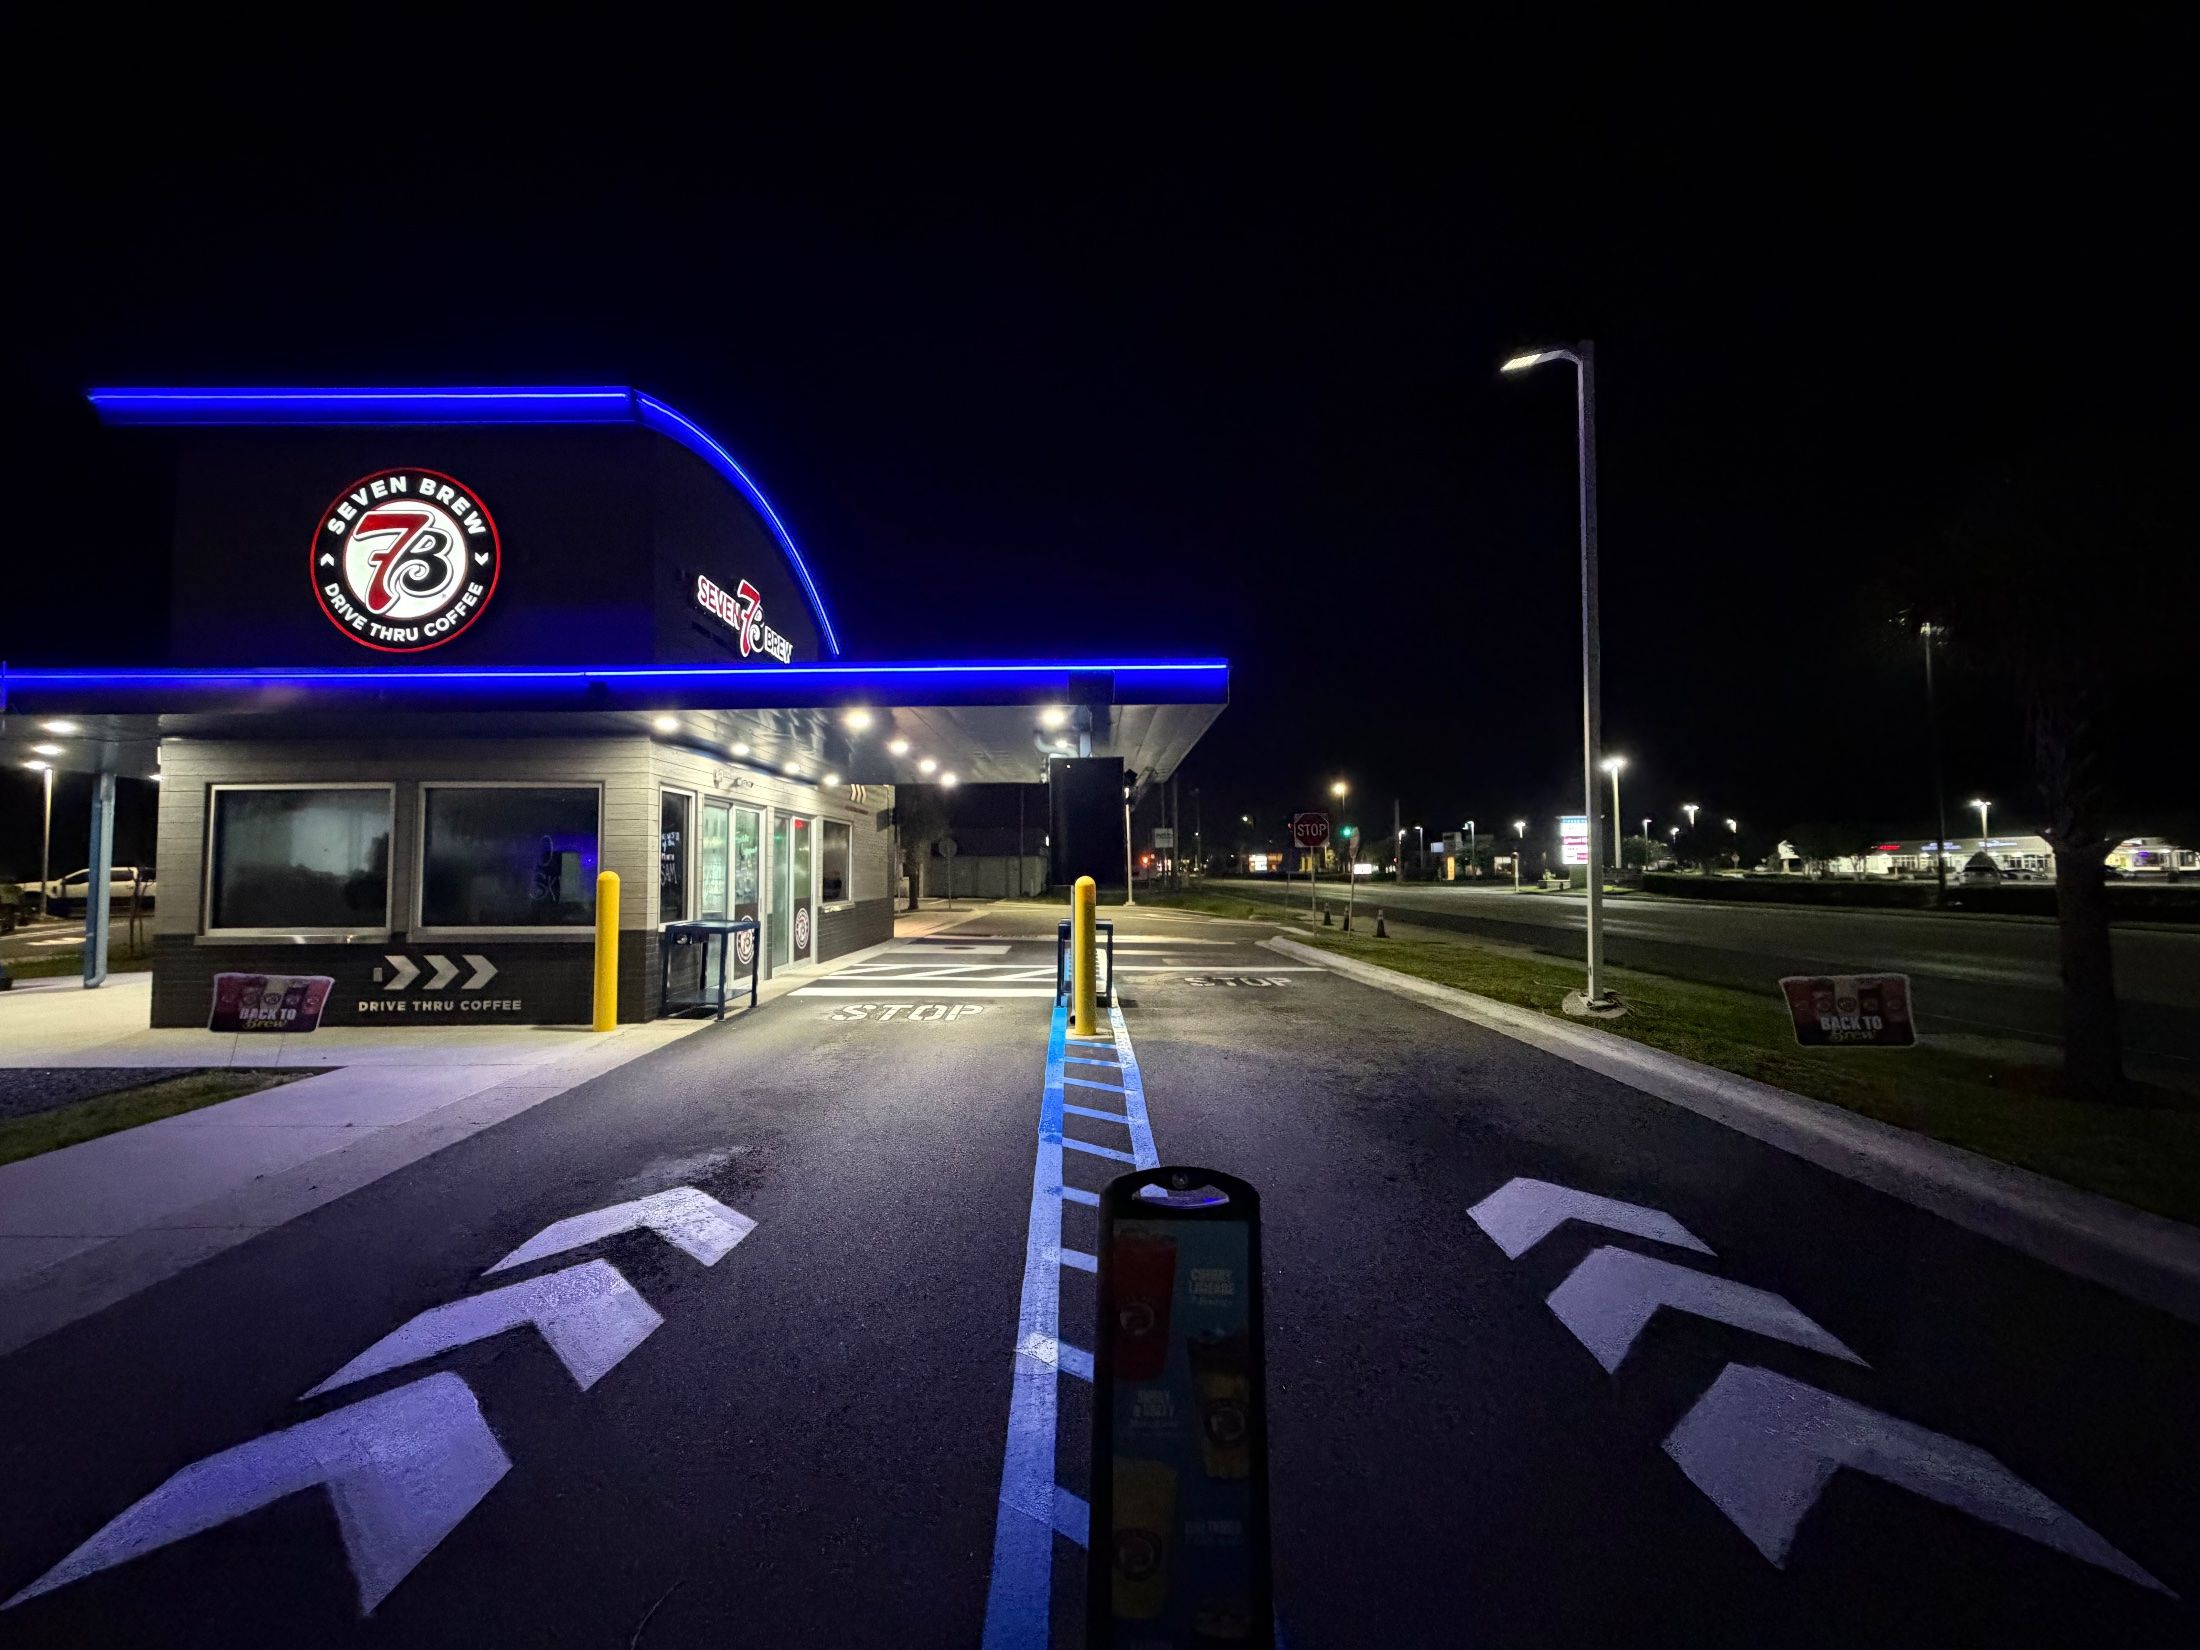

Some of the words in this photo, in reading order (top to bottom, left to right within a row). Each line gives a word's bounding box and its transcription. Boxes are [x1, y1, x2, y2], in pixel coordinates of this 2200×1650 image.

[327, 476, 407, 535] SEVEN
[419, 478, 486, 535] BREW
[324, 582, 368, 631] DRIVE
[370, 621, 419, 642] THRU
[423, 581, 484, 638] COFFEE
[697, 574, 742, 631] SEVEN
[764, 624, 794, 664] BREW
[1296, 823, 1327, 837] STOP
[1184, 977, 1292, 987] STOP
[358, 1000, 407, 1012] DRIVE
[412, 999, 455, 1012] THRU
[460, 999, 522, 1011] COFFEE
[831, 1004, 985, 1021] STOP
[239, 1008, 276, 1020] BACK
[280, 1008, 297, 1020] TO
[1820, 1016, 1861, 1031] BACK
[1862, 1016, 1883, 1030] TO
